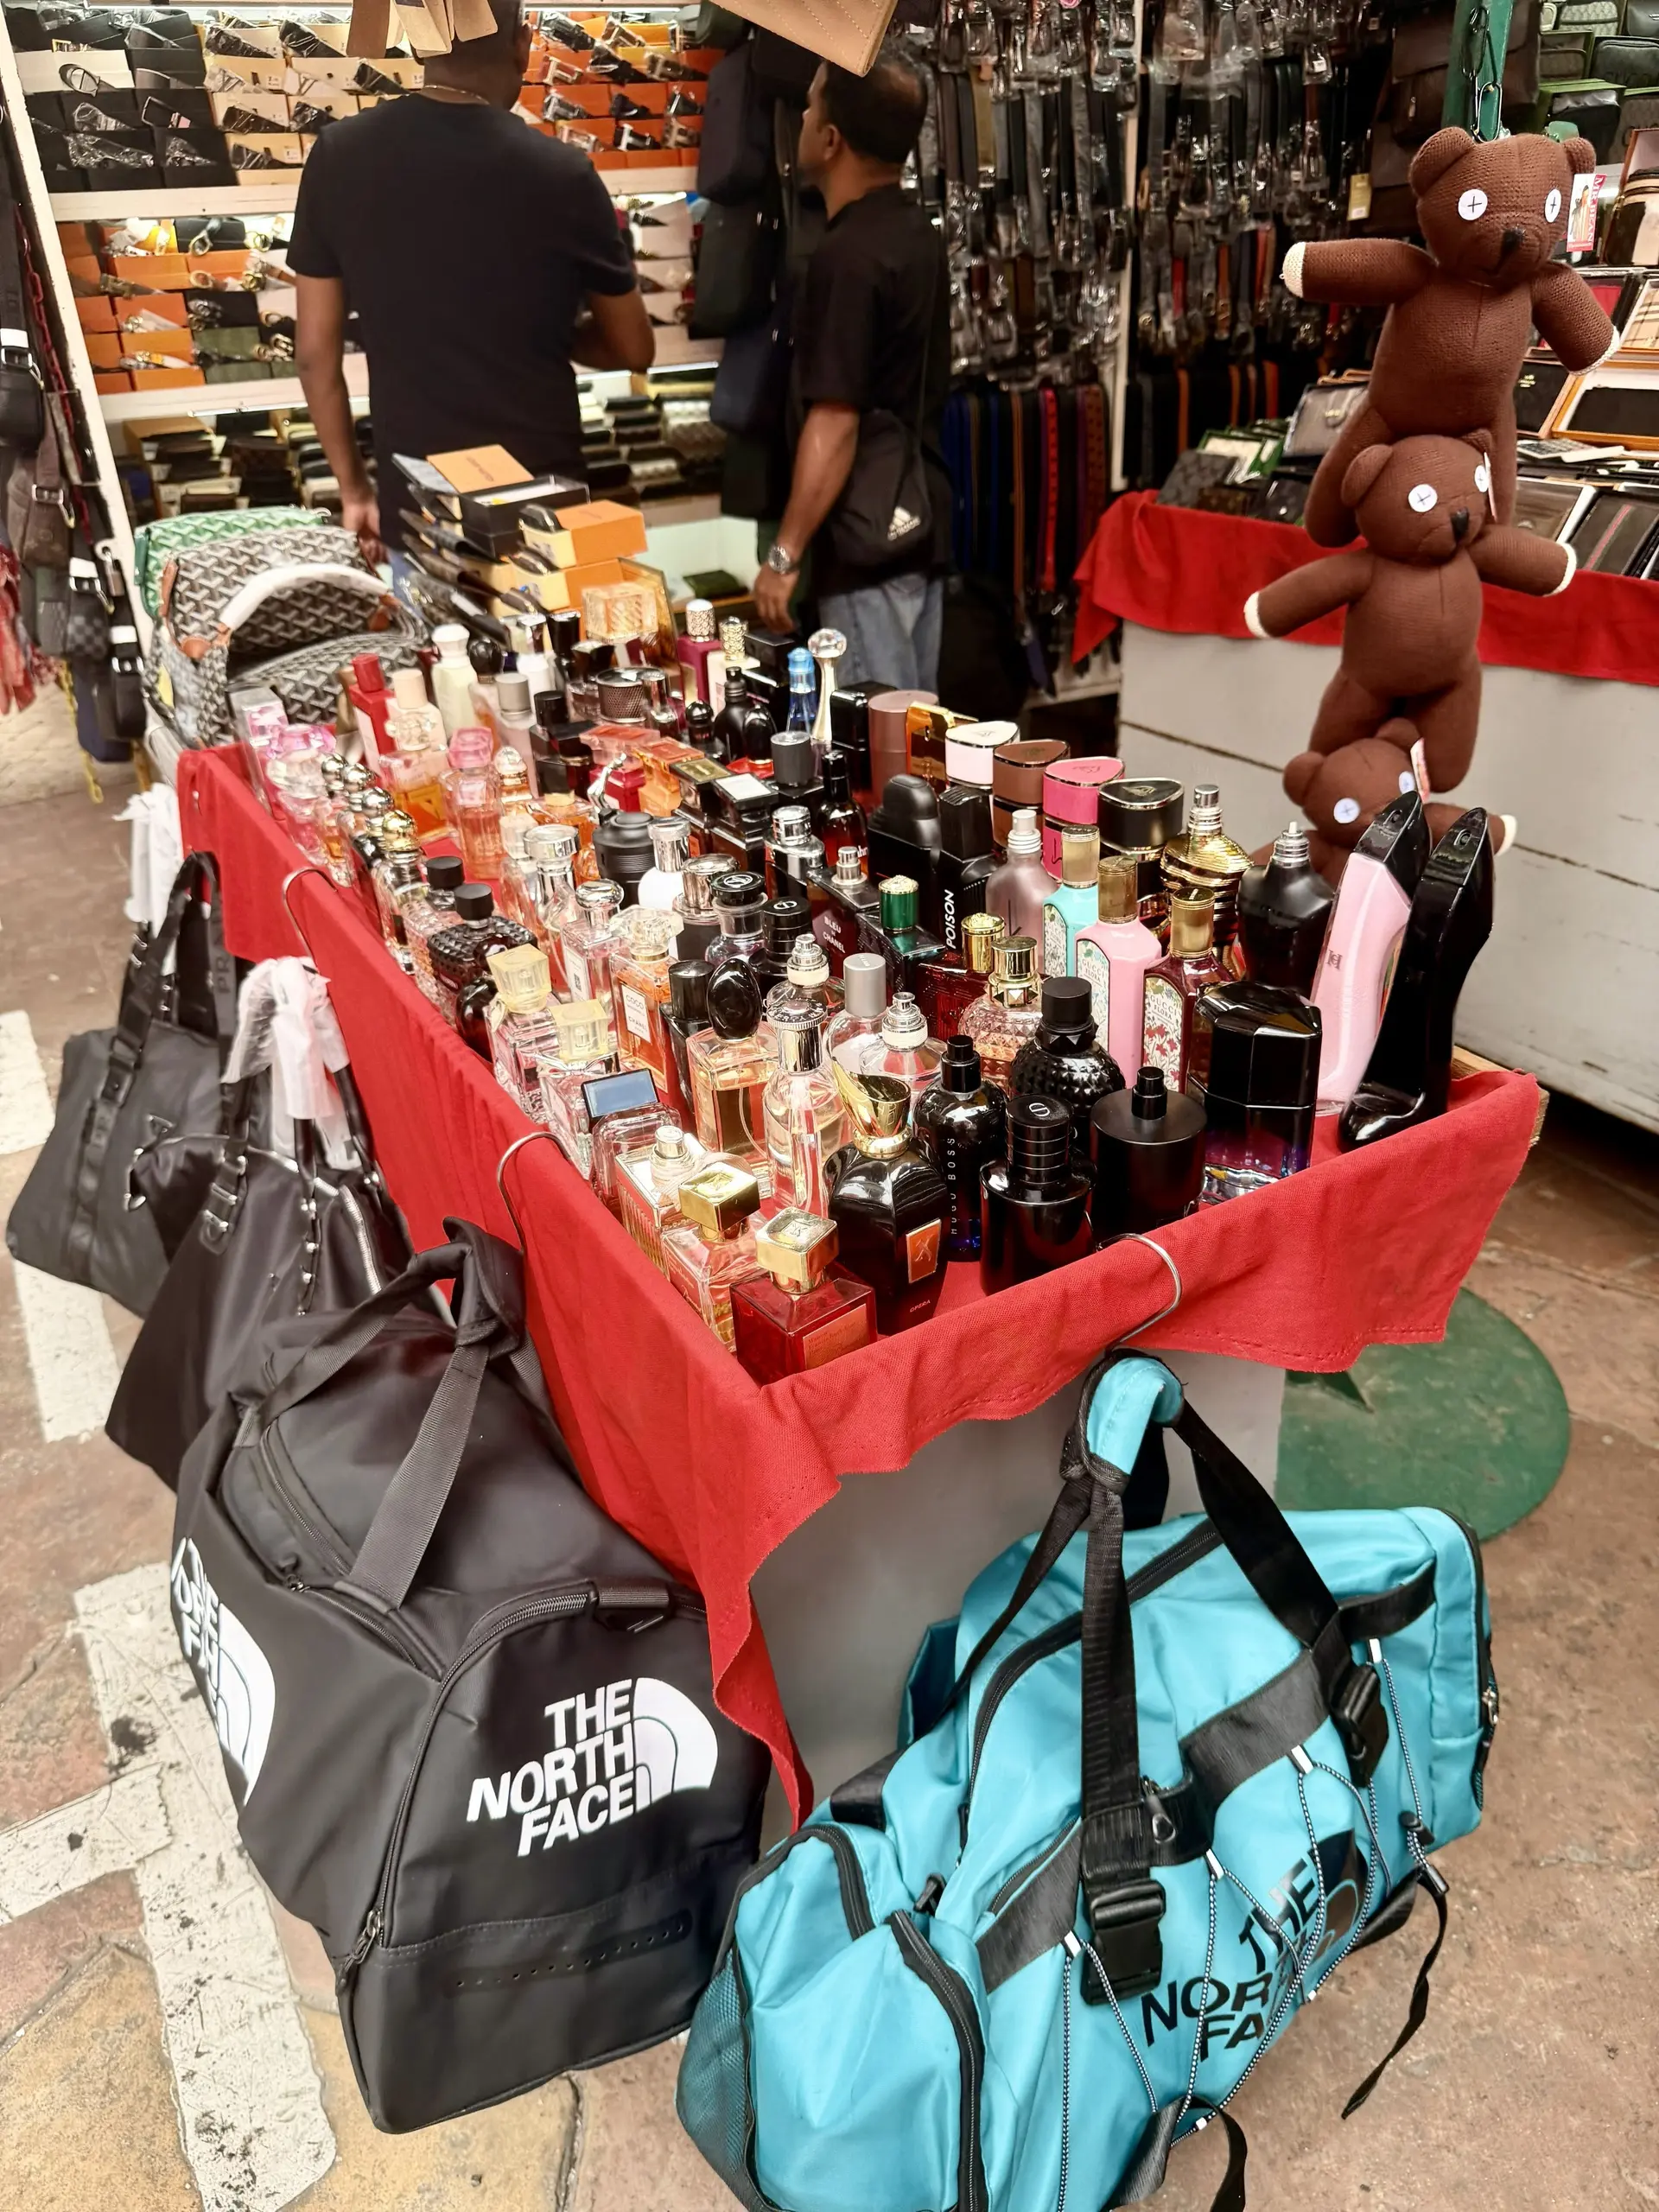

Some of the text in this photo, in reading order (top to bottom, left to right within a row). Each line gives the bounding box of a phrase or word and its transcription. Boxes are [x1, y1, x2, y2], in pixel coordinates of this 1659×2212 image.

[823, 916, 842, 934] BLEU
[944, 889, 957, 950] POISON
[823, 931, 846, 954] CHANEL
[1082, 958, 1105, 979] GUCCI
[1084, 967, 1102, 982] FLORA
[626, 995, 645, 1010] COCO
[1150, 995, 1177, 1016] GUCCI
[1154, 1004, 1173, 1020] FLORA
[947, 1137, 957, 1181] BOSS
[909, 1299, 931, 1313] OPERA
[543, 1678, 632, 1750] THE
[467, 1722, 635, 1822] NORTH
[517, 1770, 634, 1858] FACE
[1141, 1972, 1274, 2048] NOR
[1198, 2012, 1264, 2063] FA
